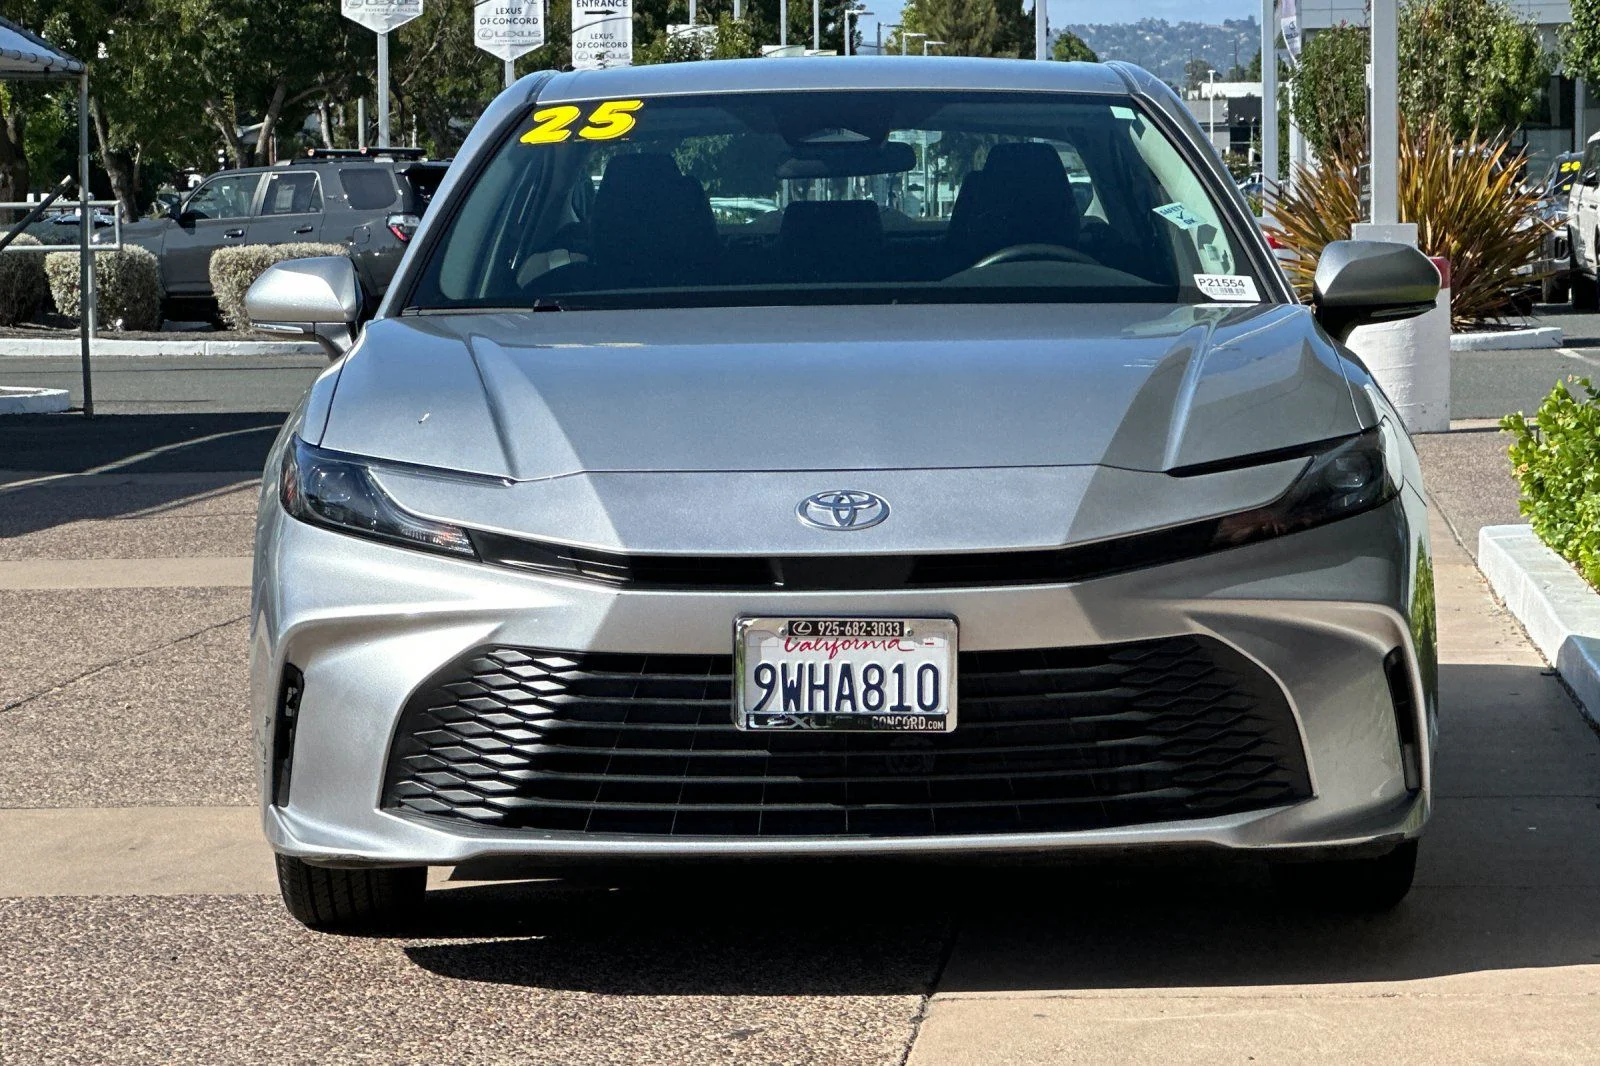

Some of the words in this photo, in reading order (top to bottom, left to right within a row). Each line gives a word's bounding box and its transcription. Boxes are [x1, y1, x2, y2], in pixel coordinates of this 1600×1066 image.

[479, 17, 491, 25] OF
[492, 17, 539, 25] CONCORD
[576, 41, 586, 49] OF
[587, 41, 628, 49] CONCORD
[520, 100, 644, 144] 25
[1198, 279, 1245, 287] P21554
[817, 622, 900, 636] 925-682-3033
[784, 637, 915, 660] California
[753, 663, 940, 712] 9WHA810
